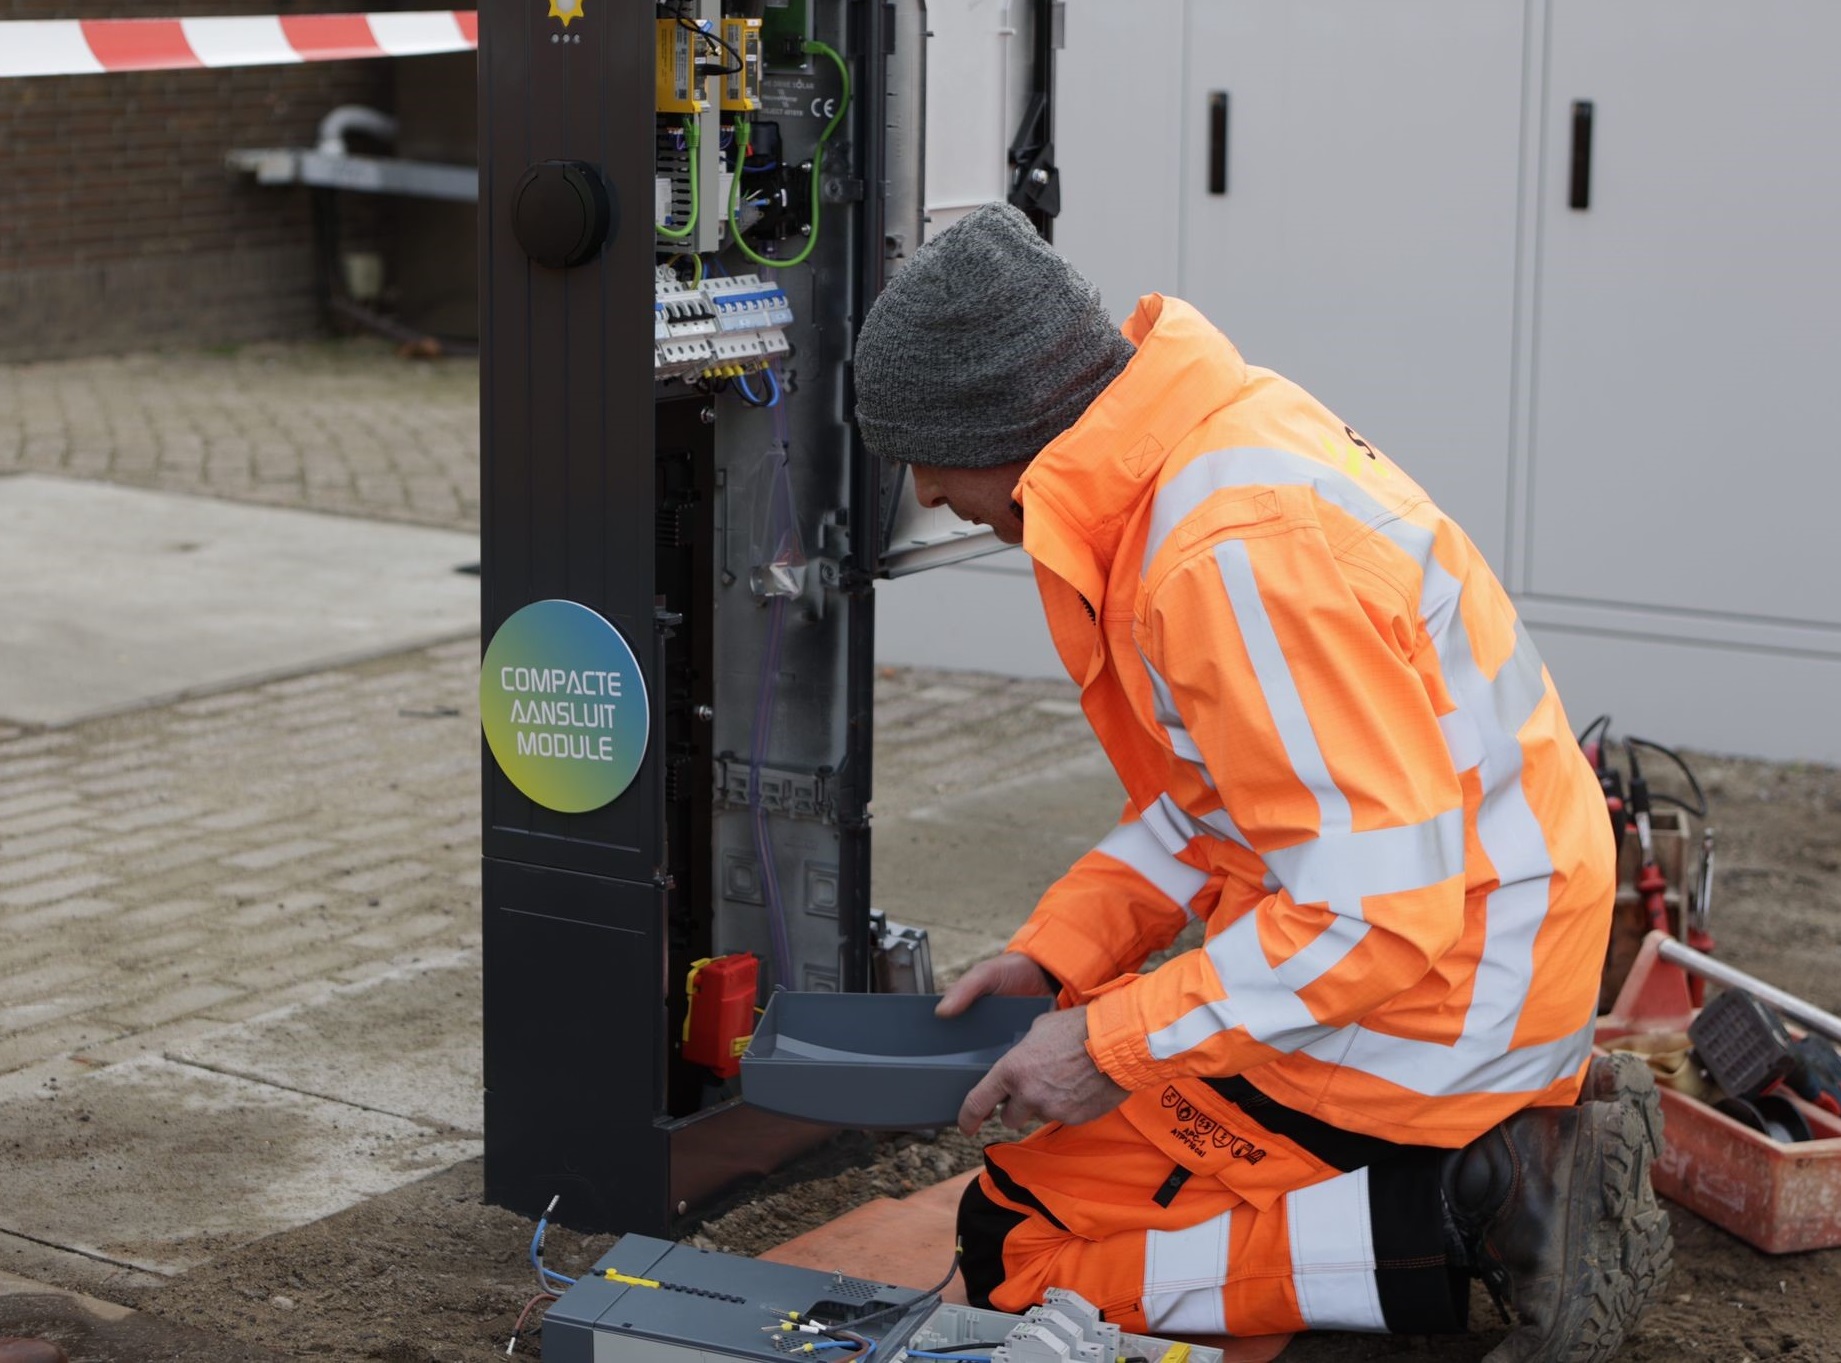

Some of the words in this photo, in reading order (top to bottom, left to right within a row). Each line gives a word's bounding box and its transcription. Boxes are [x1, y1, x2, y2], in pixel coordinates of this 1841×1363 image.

[810, 97, 835, 119] CE
[500, 666, 622, 697] COMPACTE
[510, 699, 616, 729] AANSLUIT
[516, 731, 613, 762] MODULE
